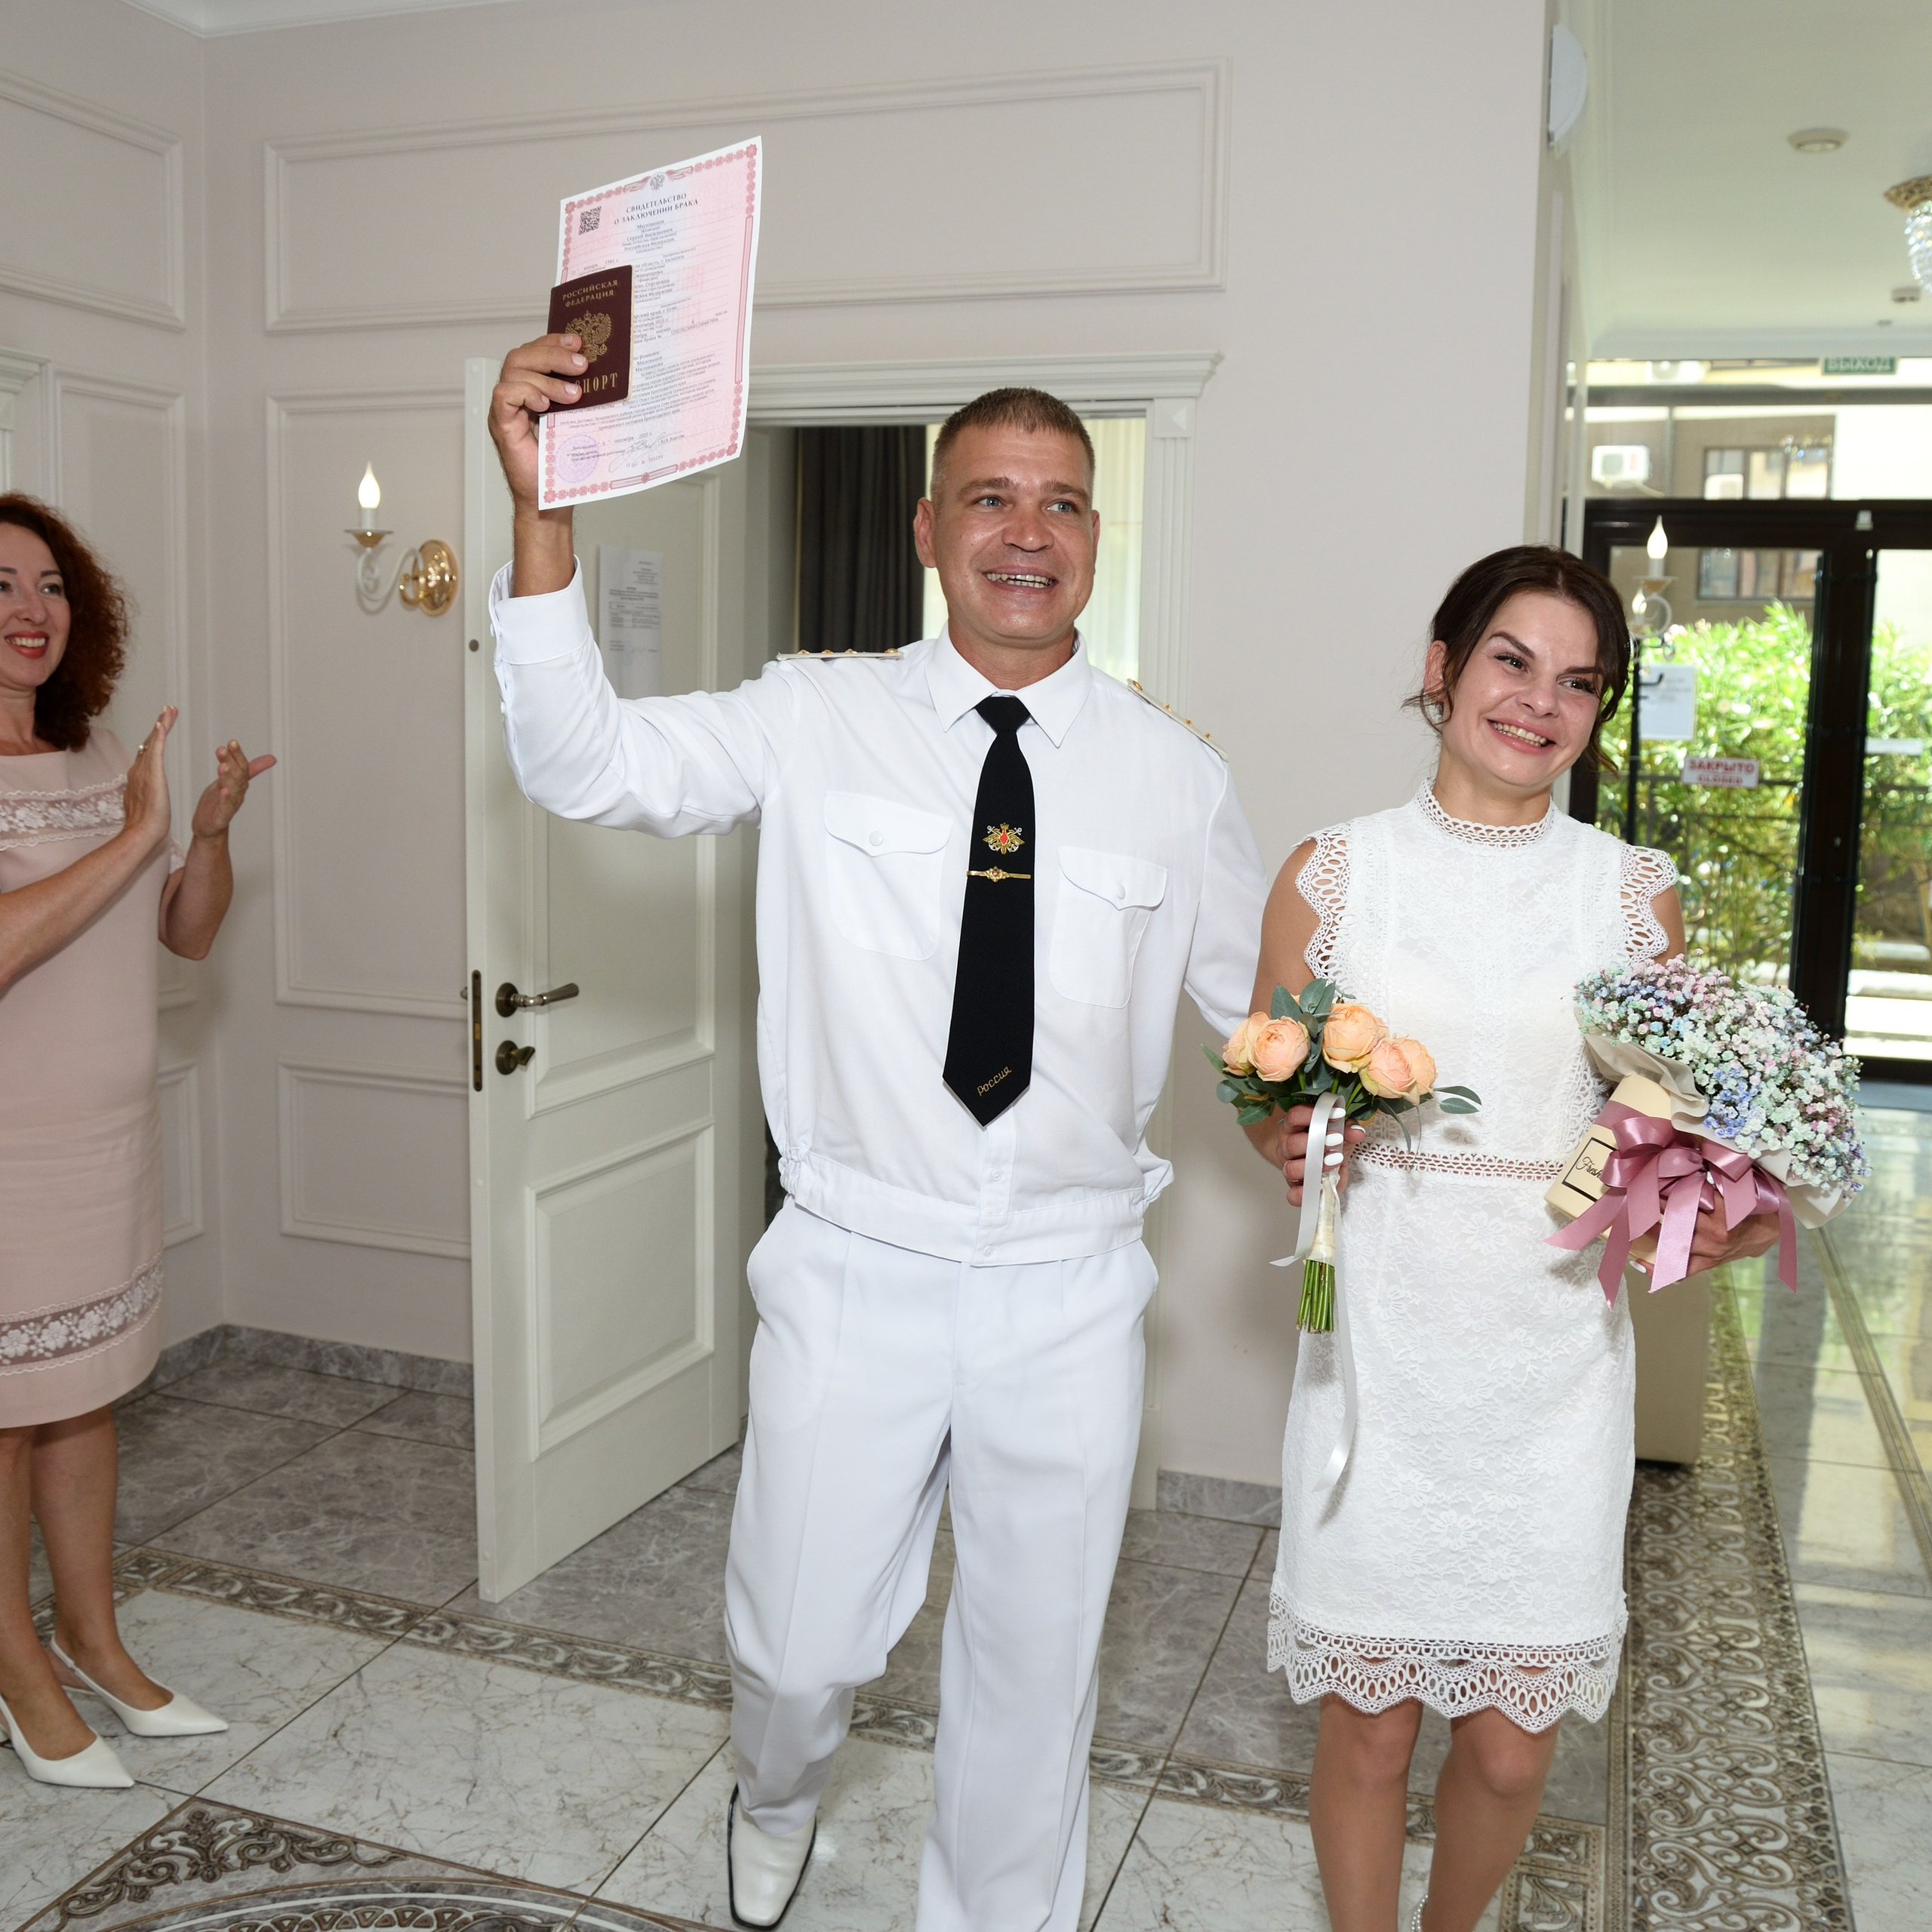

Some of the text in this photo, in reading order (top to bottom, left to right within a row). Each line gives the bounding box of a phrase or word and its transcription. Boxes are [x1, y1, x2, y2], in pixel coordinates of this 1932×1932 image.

[622, 206, 672, 223] ЗАКЛЮЧЕНИИ
[675, 199, 698, 210] БРАКА
[626, 193, 687, 213] СВИДЕТЕЛЬСТВО
[562, 279, 617, 300] РОССИЙСКАЯ
[565, 289, 614, 307] ФЕДЕРАЦИЯ
[1828, 357, 1891, 372] ВЫХОД
[575, 373, 617, 392] ПОРТ
[1688, 758, 1755, 774] ЗАКРЫТО
[1697, 774, 1743, 784] CLOSED
